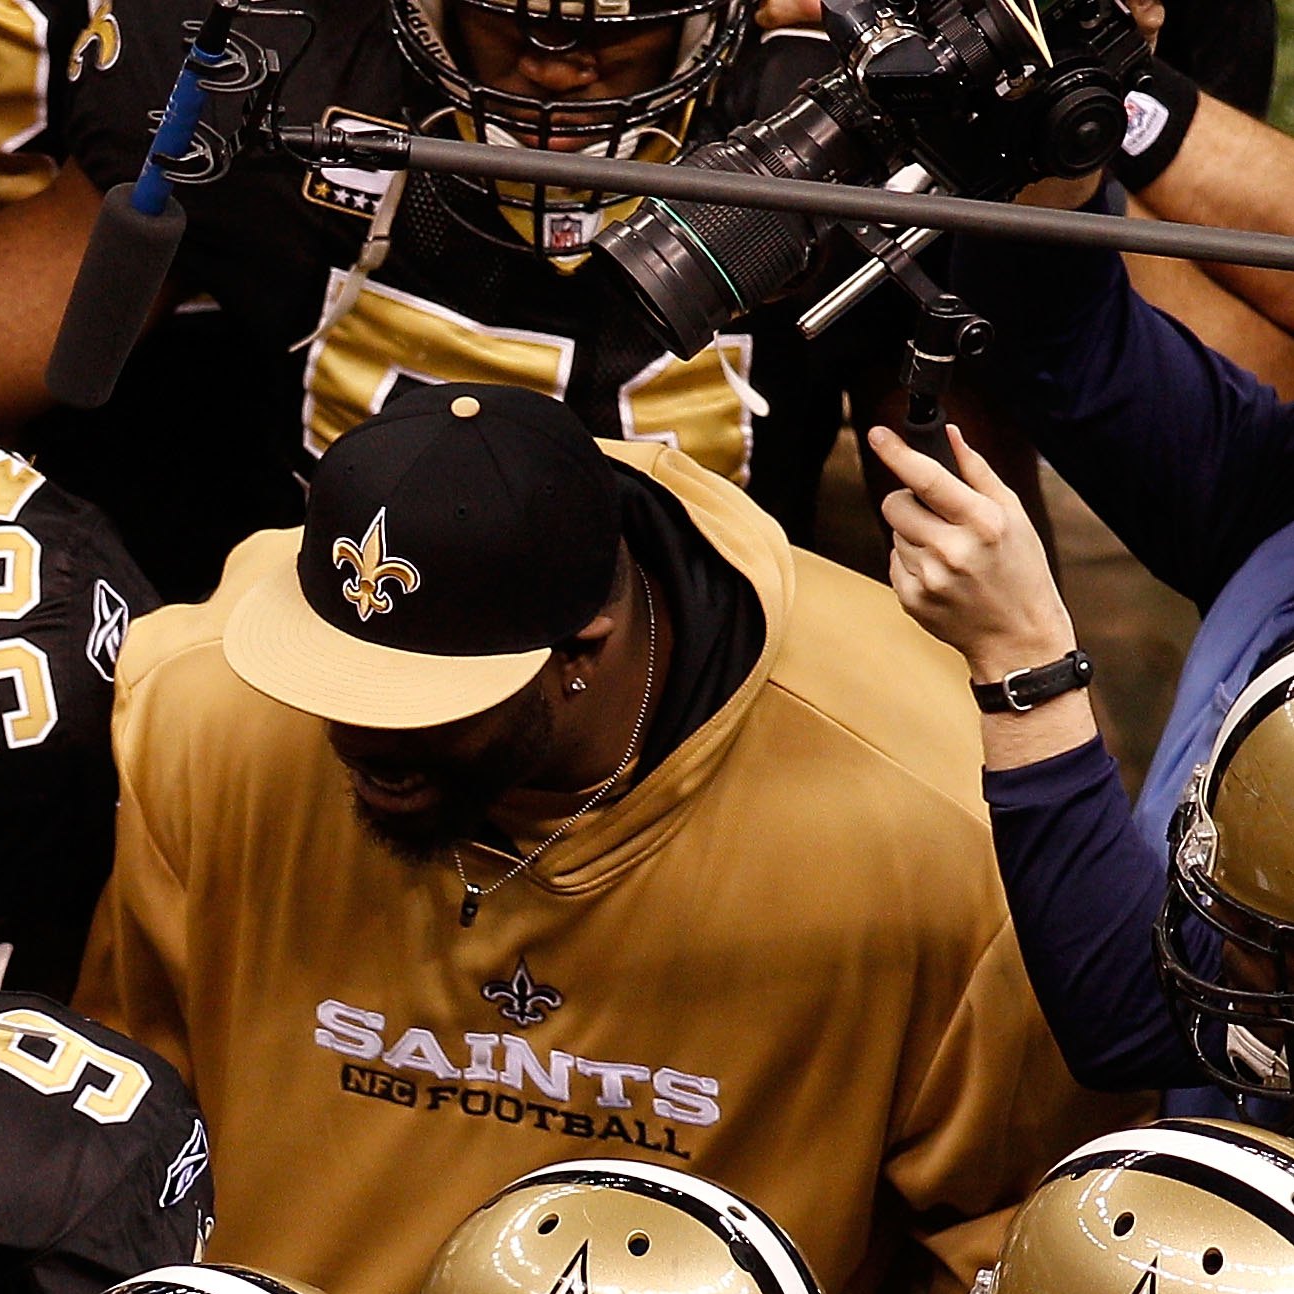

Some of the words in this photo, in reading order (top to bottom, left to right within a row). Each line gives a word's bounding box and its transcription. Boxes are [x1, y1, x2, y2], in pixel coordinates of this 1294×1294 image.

[315, 999, 721, 1127] SAINTS
[346, 1066, 411, 1100] NFC
[426, 1085, 691, 1161] FOOTBALL
